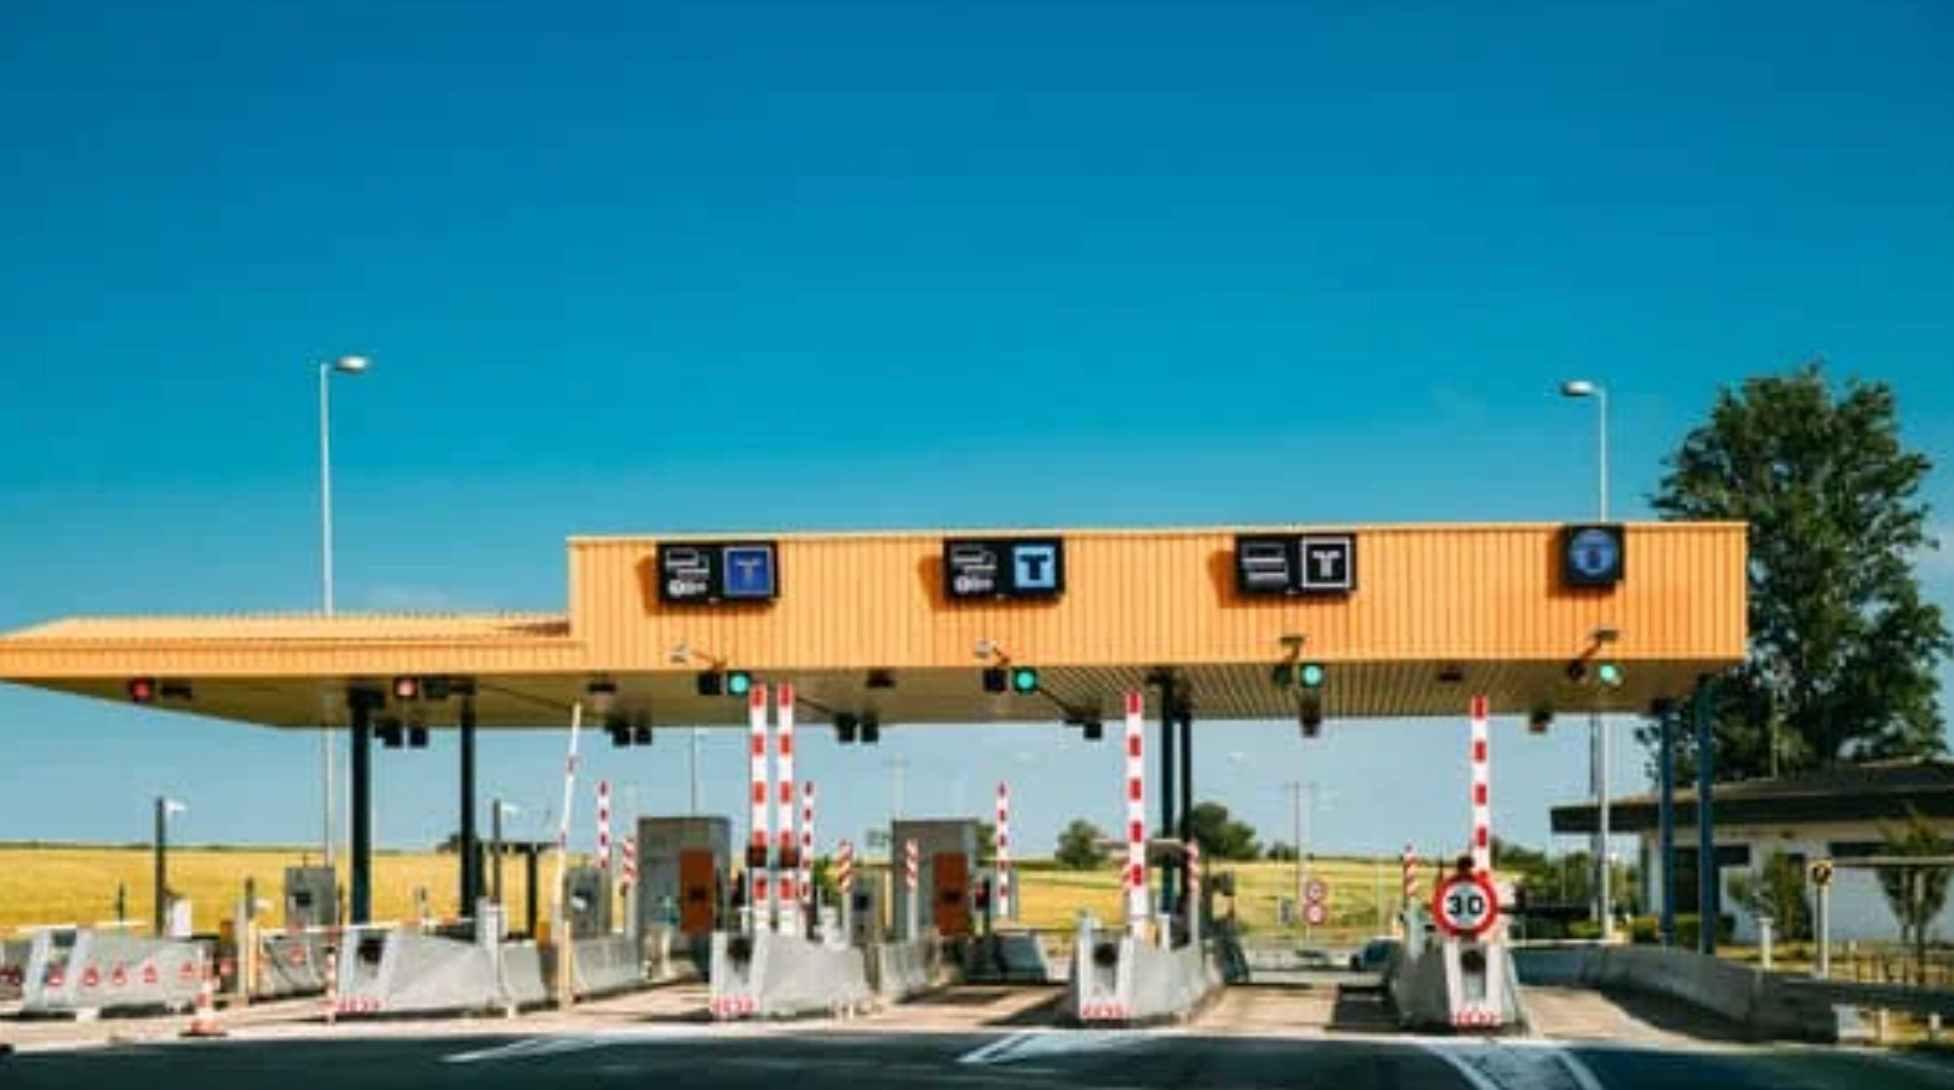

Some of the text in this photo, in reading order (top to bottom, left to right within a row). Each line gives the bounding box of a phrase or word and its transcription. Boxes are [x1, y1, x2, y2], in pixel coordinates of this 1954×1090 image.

[1020, 554, 1048, 580] T
[1312, 550, 1341, 577] T
[1447, 895, 1485, 918] 30
